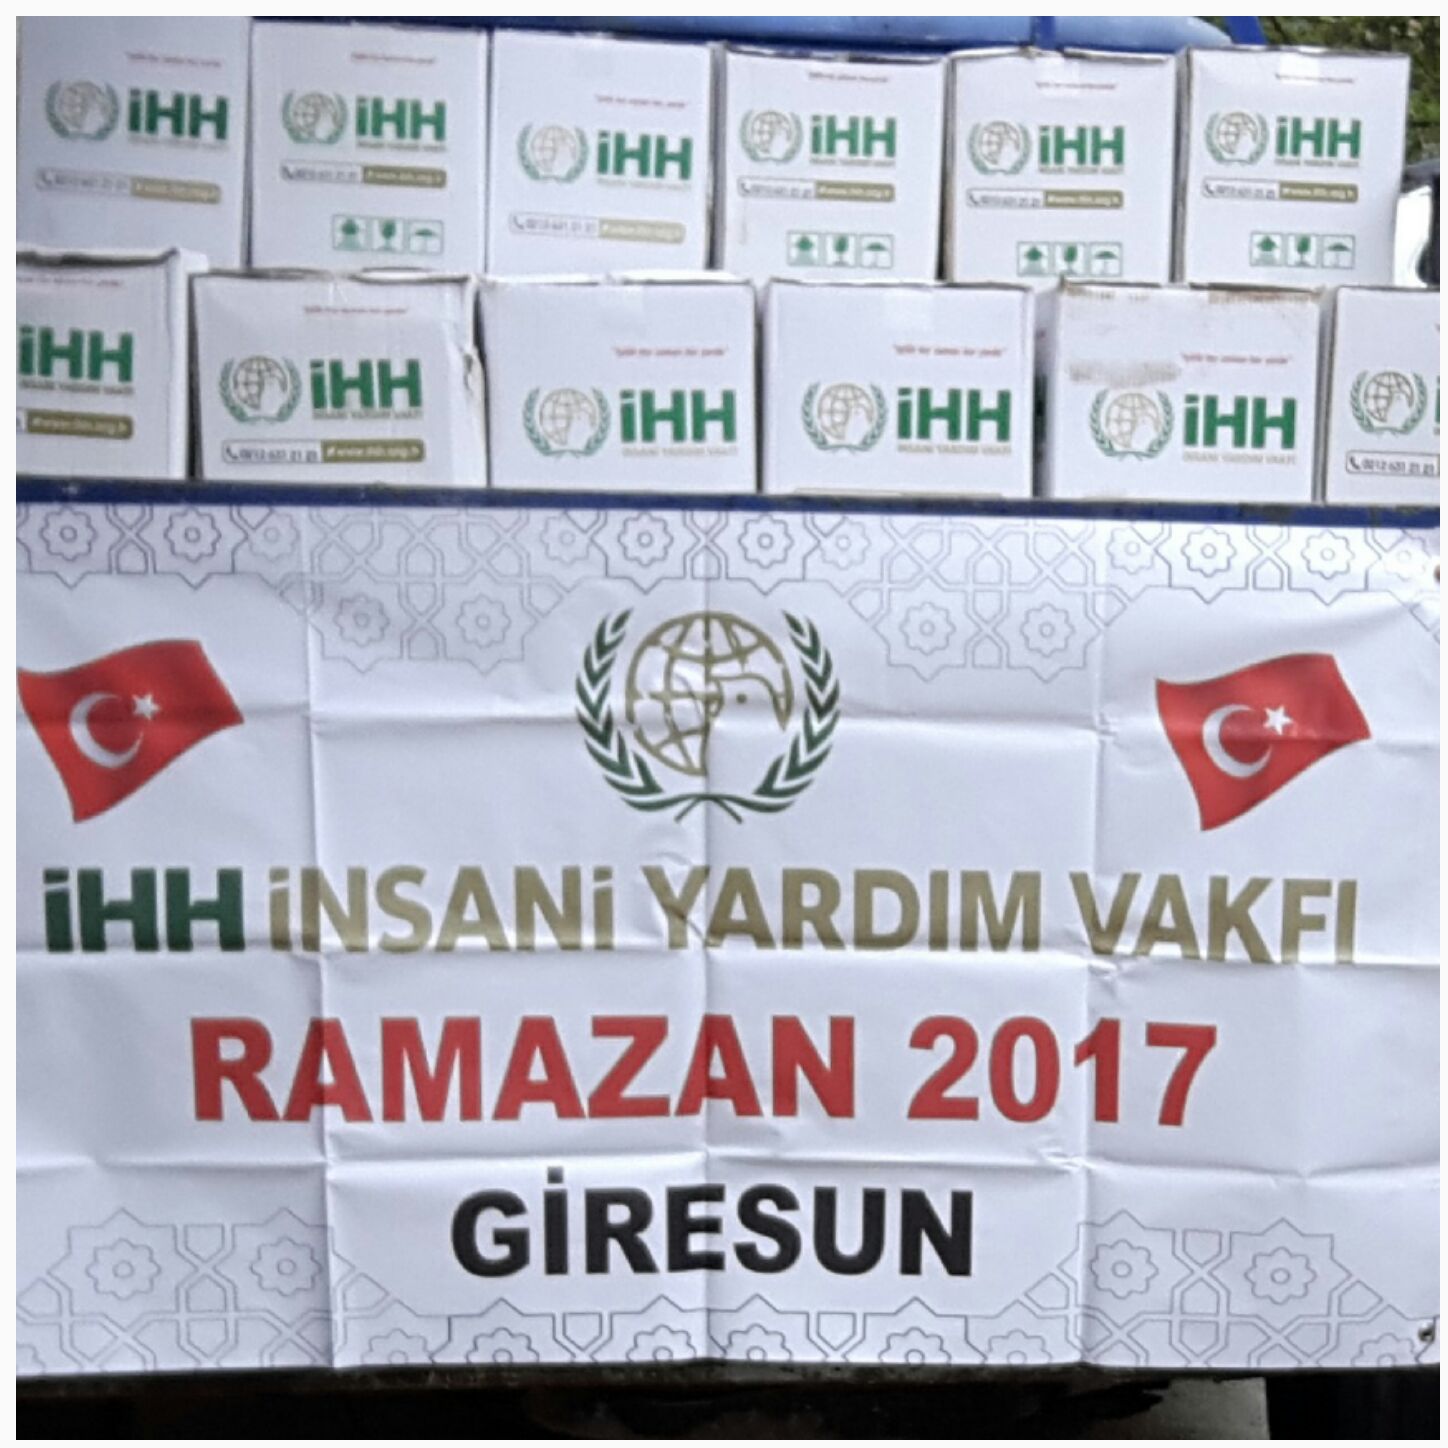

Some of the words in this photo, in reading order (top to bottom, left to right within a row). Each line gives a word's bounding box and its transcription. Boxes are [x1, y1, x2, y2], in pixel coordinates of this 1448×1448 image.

[642, 866, 1041, 951] YARDIM
[1070, 872, 1358, 964] VAKFI
[190, 1014, 855, 1123] RAMAZAN
[907, 1016, 1218, 1126] 2017
[450, 1167, 973, 1278] GİRESUN
